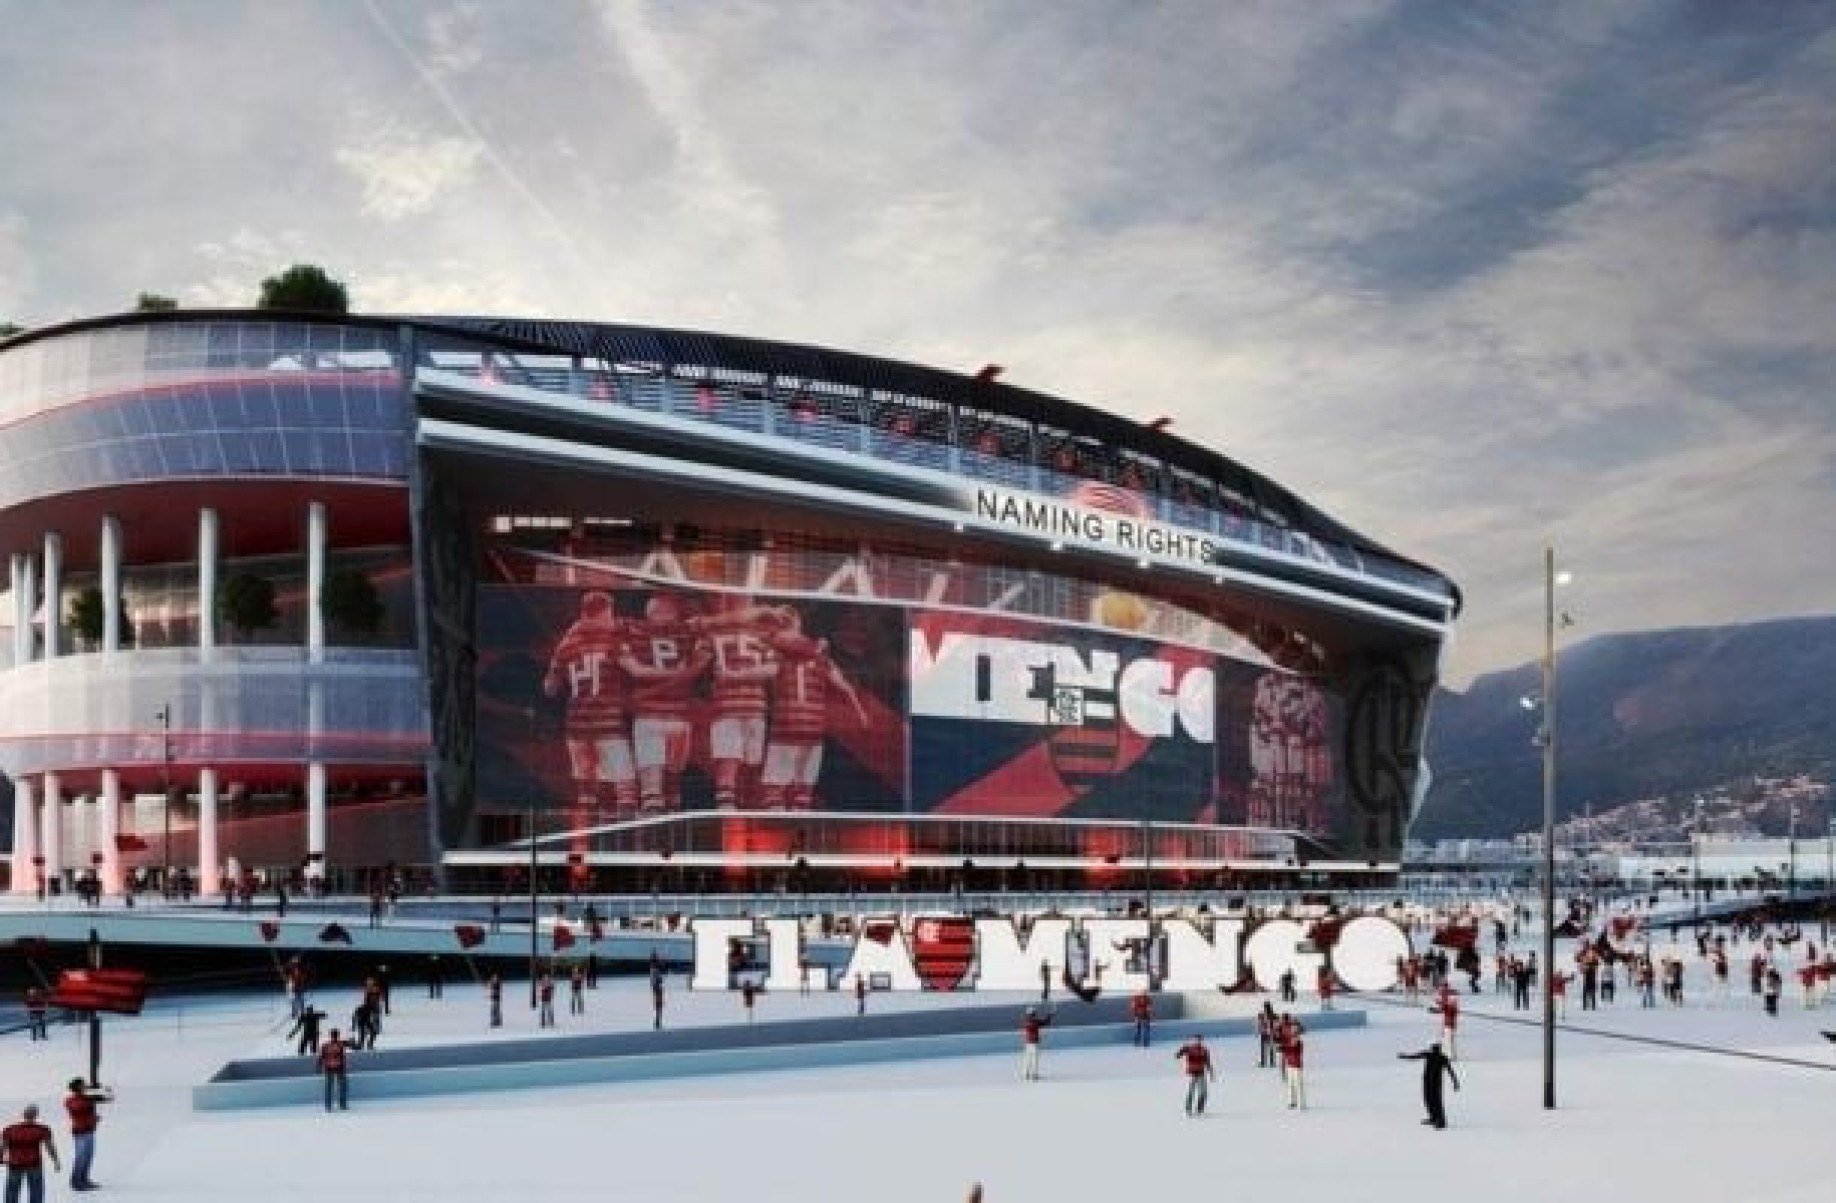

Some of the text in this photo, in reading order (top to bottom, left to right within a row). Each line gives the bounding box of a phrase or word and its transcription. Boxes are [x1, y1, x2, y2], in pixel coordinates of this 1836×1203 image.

[977, 489, 1217, 563] NAMING RIGHTS
[691, 916, 1410, 991] FLAMENGO
